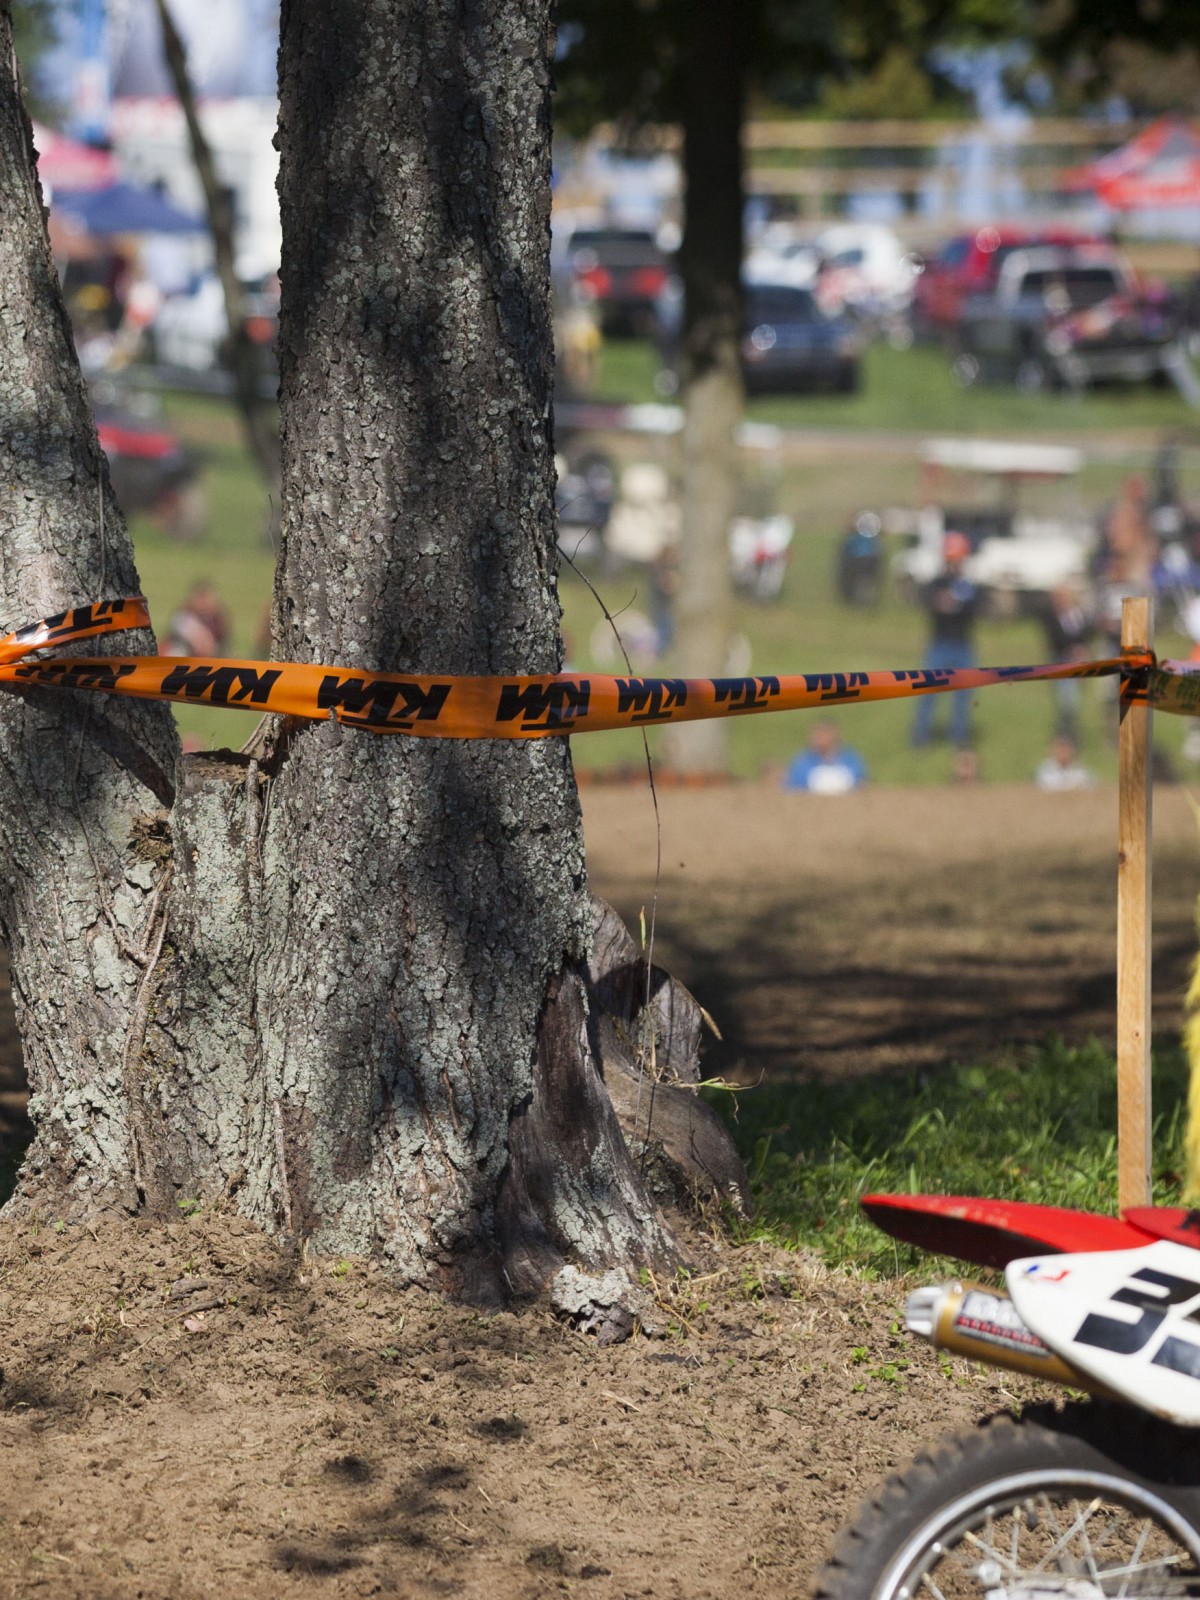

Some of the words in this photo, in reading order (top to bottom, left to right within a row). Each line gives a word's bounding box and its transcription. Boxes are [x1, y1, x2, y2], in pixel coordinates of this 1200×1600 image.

[317, 675, 452, 729] KTM
[495, 679, 590, 732] KTM
[614, 679, 688, 721] KTM
